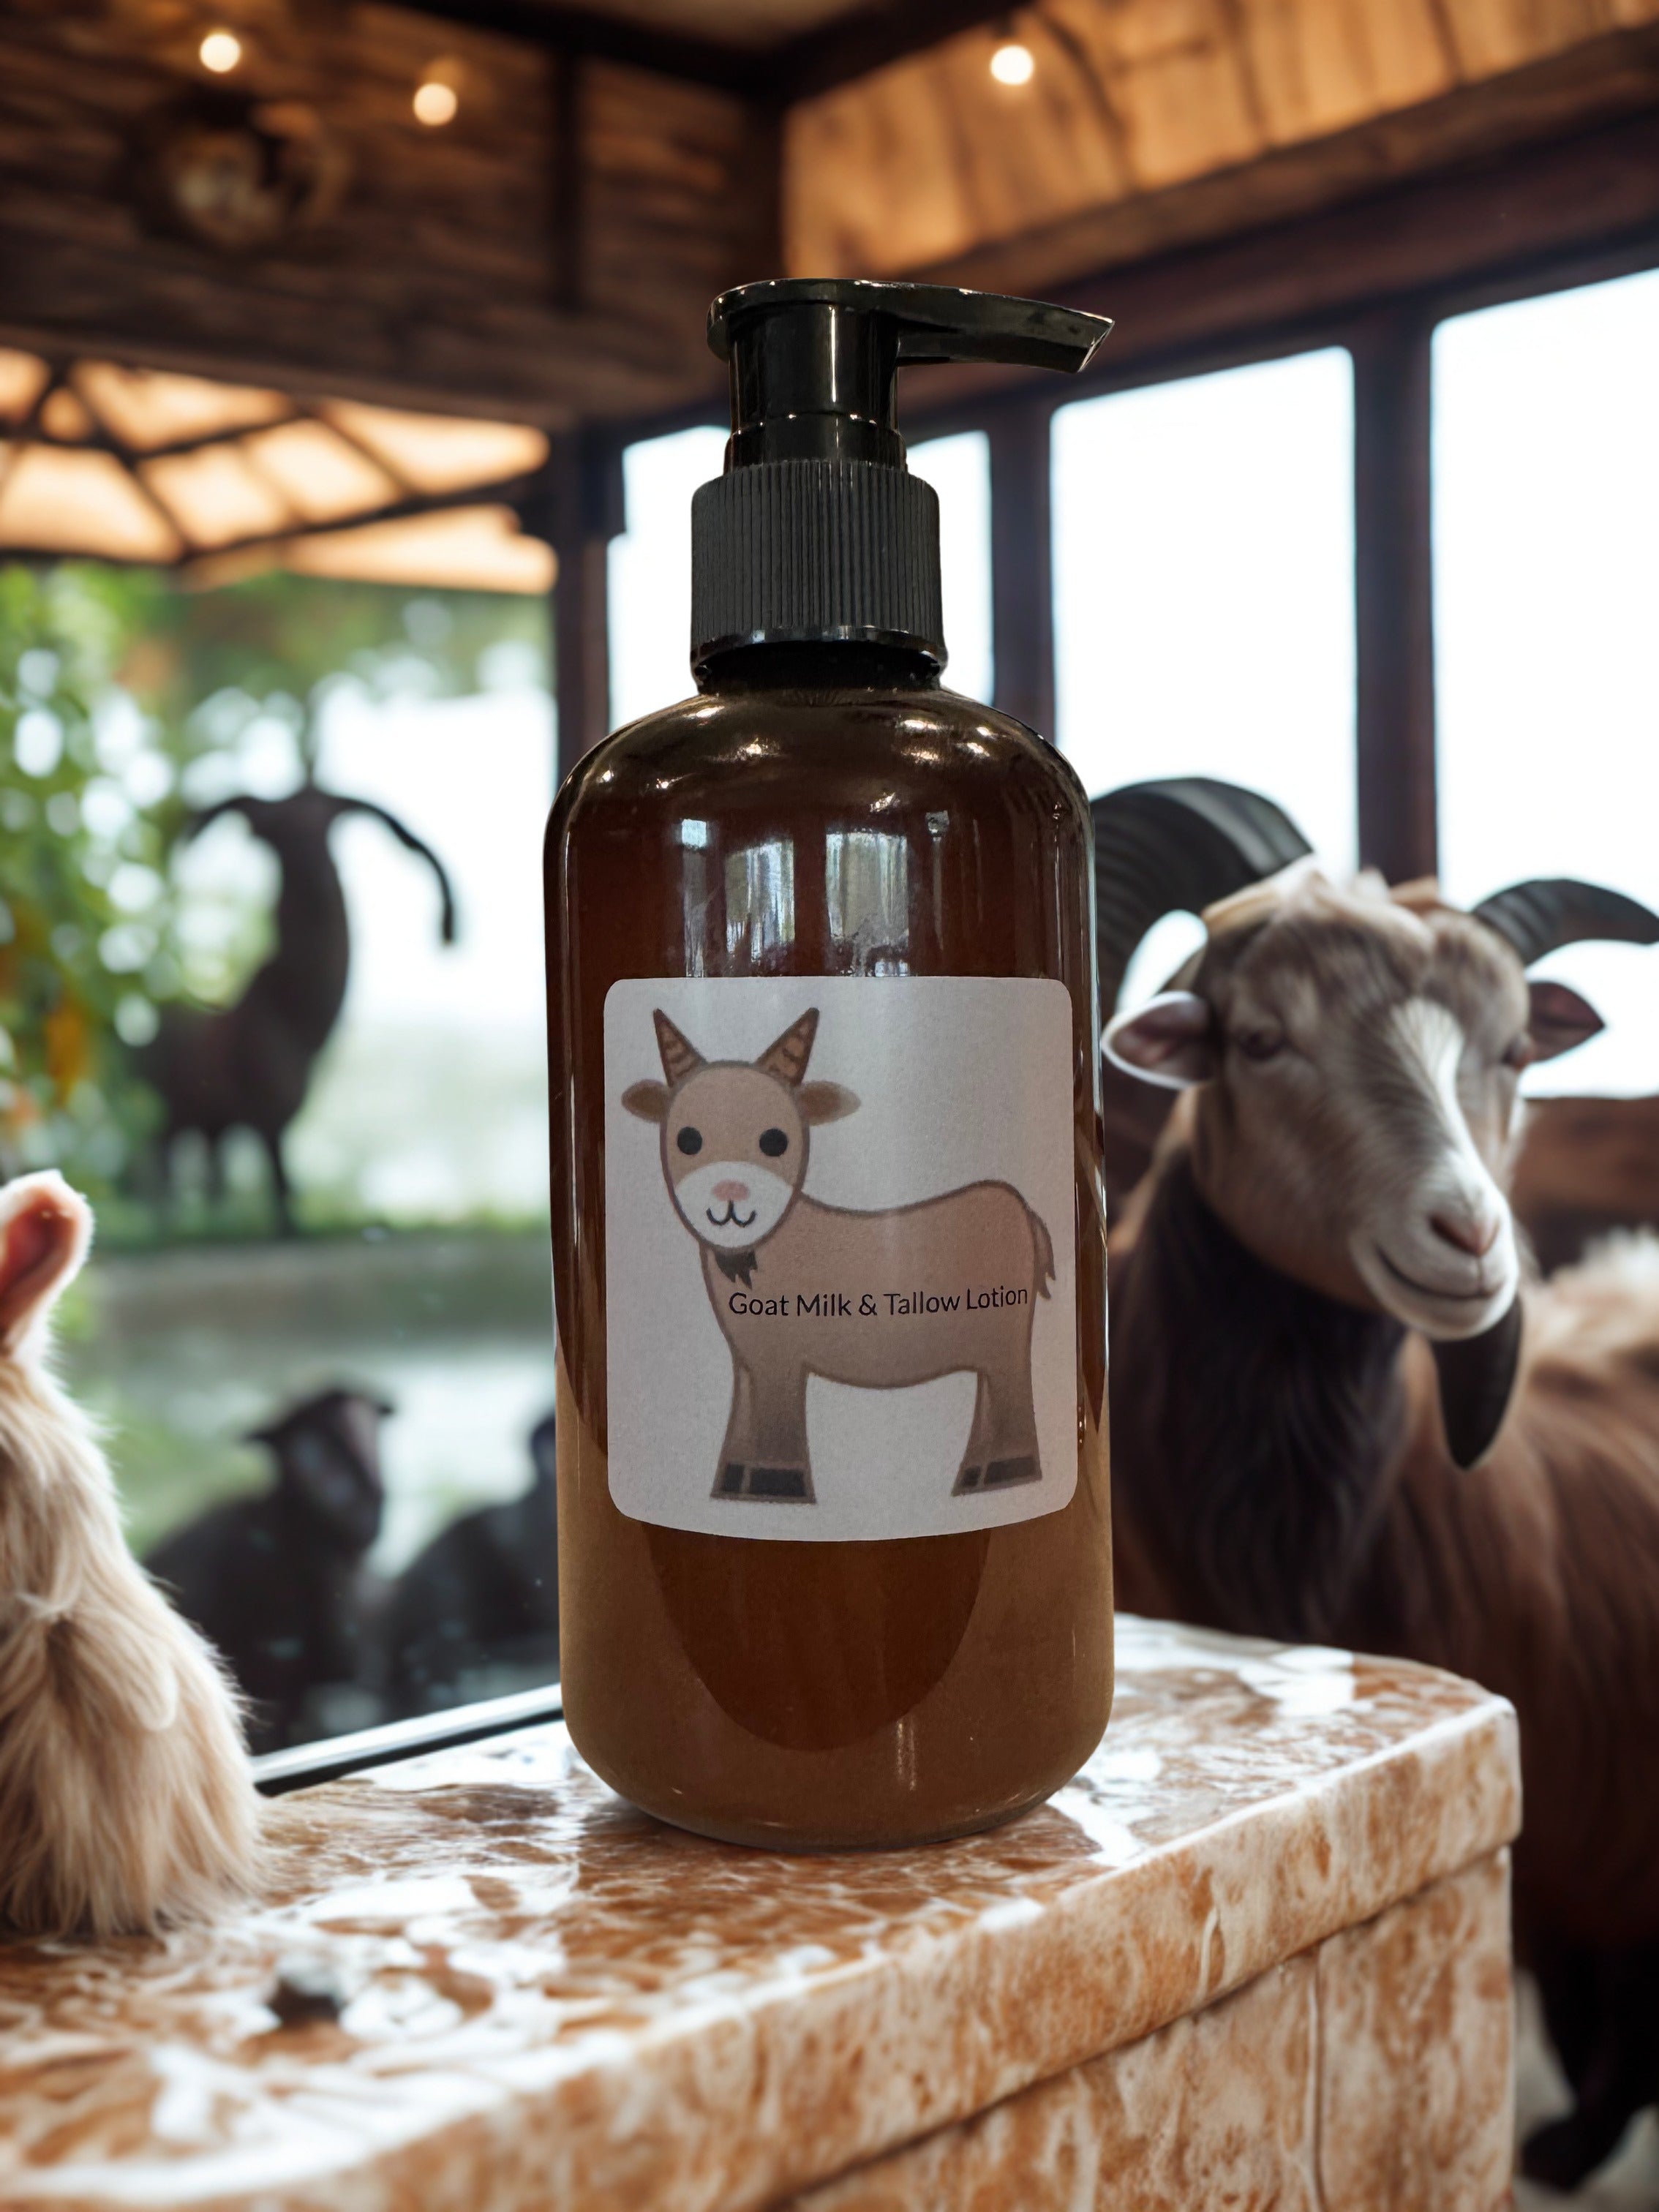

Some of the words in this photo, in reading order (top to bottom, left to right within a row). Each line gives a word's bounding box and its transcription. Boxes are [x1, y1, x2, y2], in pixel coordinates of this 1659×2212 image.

[729, 1292, 789, 1316] Goat
[797, 1293, 852, 1317] Milk
[858, 1293, 878, 1317] &
[883, 1290, 960, 1316] Tallow
[966, 1284, 1028, 1310] Lotion
